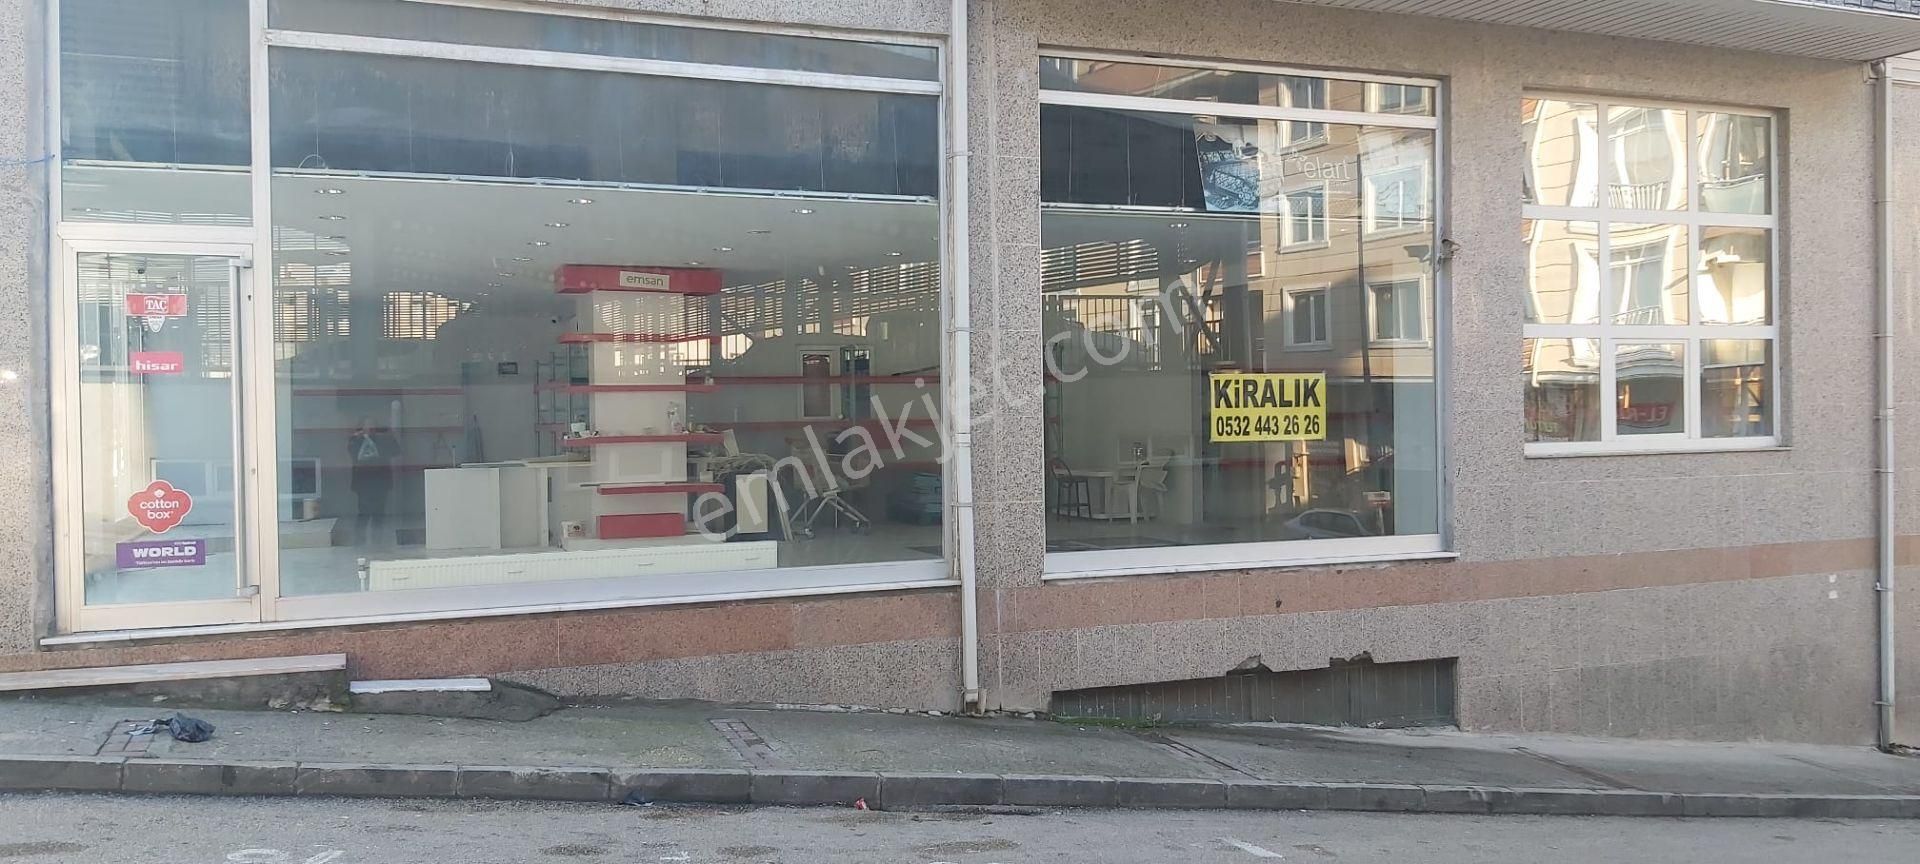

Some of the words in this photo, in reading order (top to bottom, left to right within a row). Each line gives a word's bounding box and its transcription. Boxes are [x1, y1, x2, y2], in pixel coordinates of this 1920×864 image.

[626, 274, 664, 287] emsan
[135, 360, 178, 371] hisar
[1216, 415, 1250, 437] 0532
[1254, 414, 1279, 436] 443
[1283, 414, 1300, 435] 26
[1303, 414, 1320, 435] 26
[139, 499, 179, 510] cotton
[147, 509, 171, 520] box
[132, 546, 197, 559] WORLD
